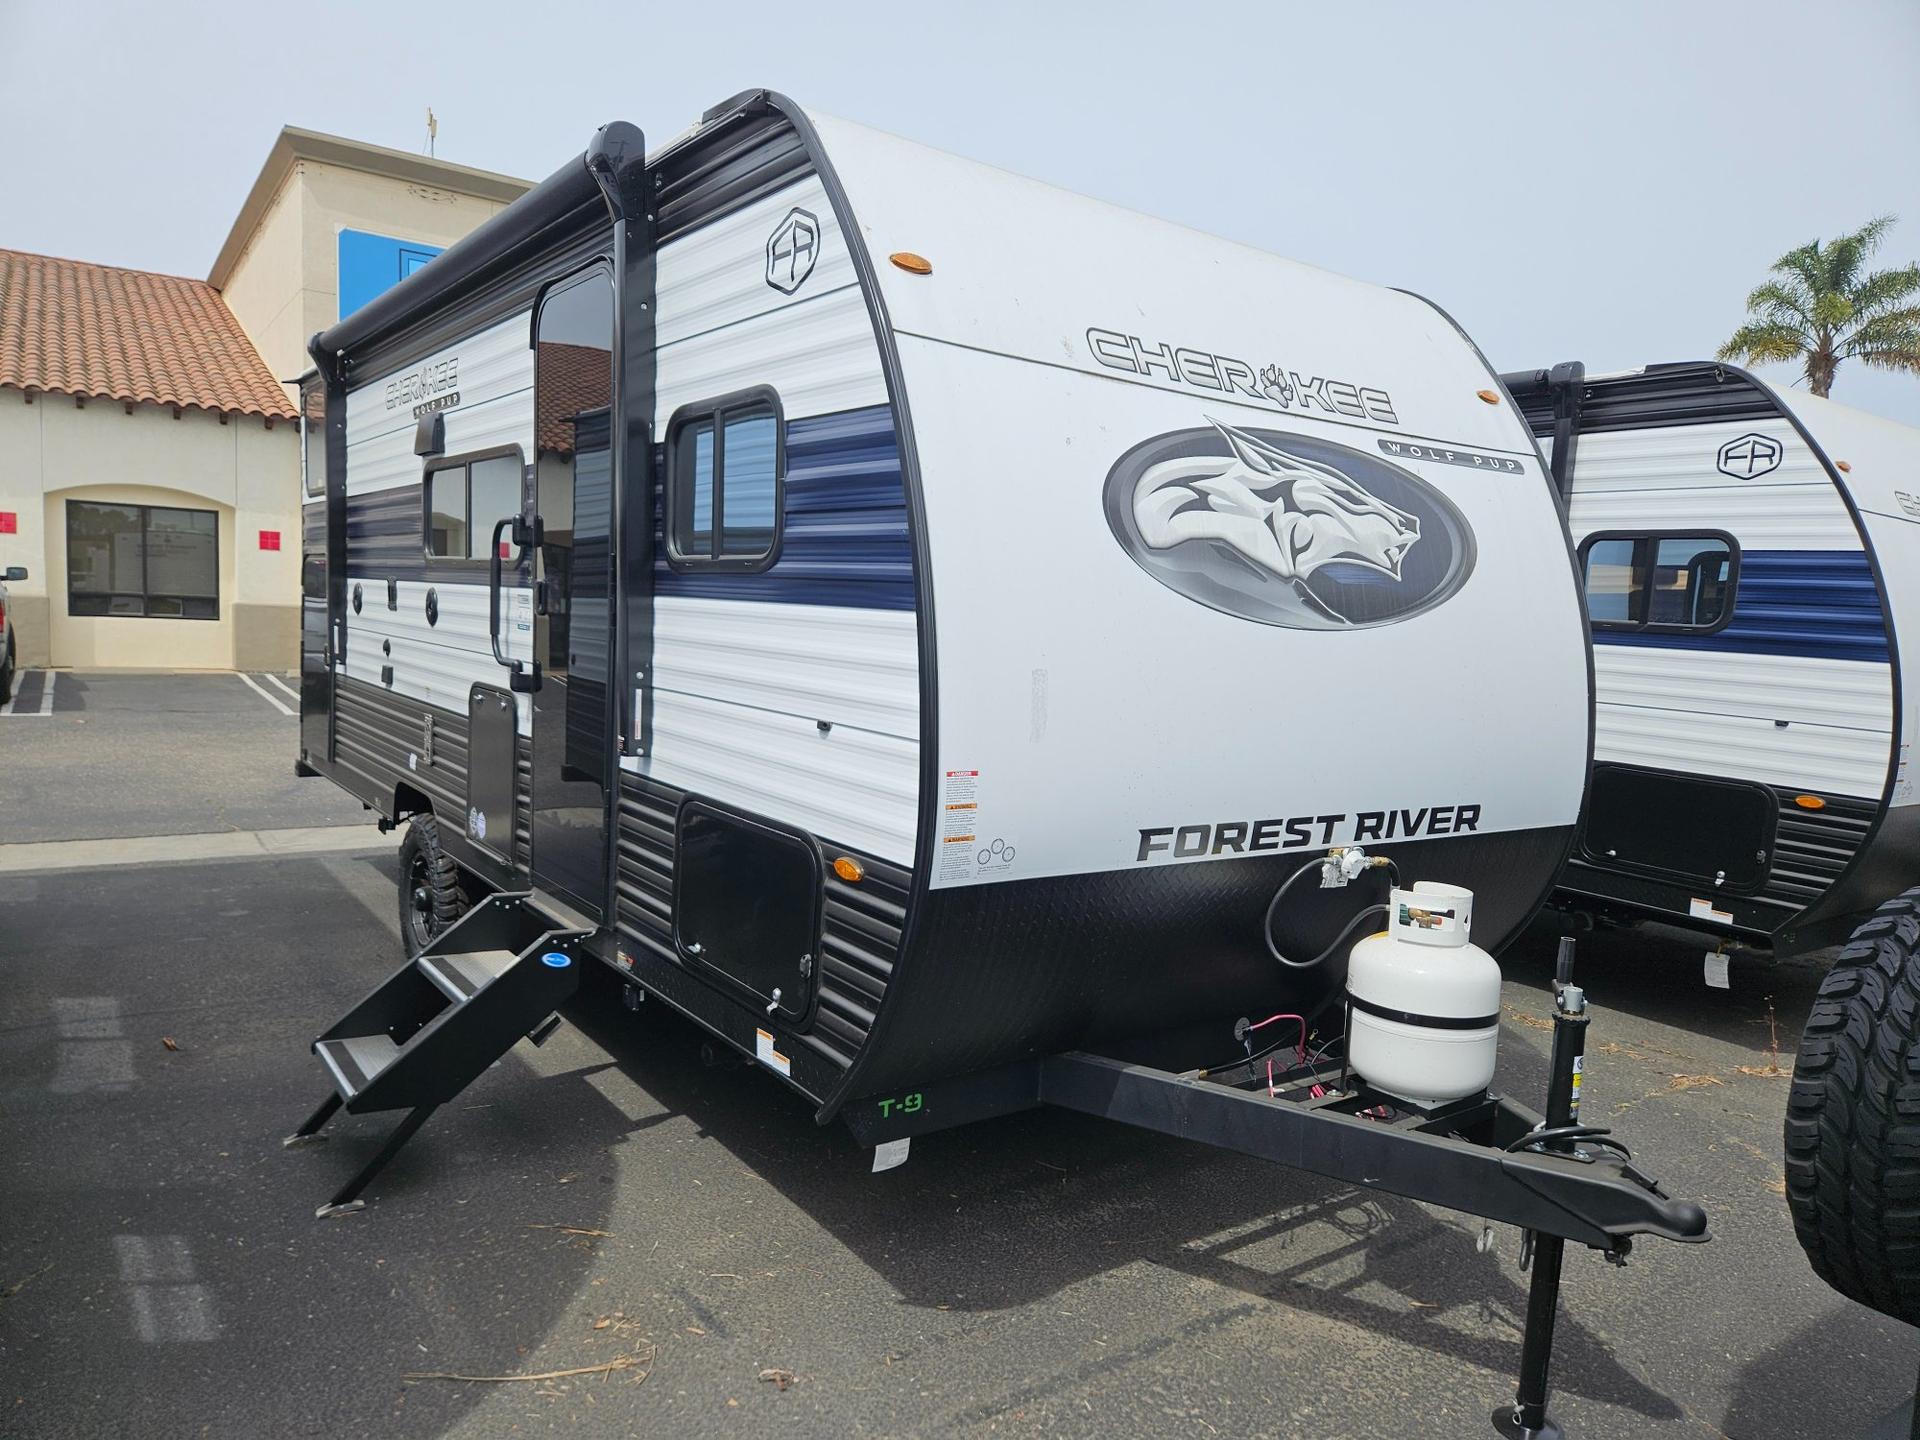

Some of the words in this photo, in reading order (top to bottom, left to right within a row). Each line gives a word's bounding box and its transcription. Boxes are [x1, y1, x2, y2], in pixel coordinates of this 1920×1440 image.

[441, 393, 458, 409] PUP
[1387, 442, 1454, 462] WOLF
[1473, 456, 1515, 471] PUP
[1136, 814, 1346, 862] FOREST
[1354, 804, 1481, 842] RIVER
